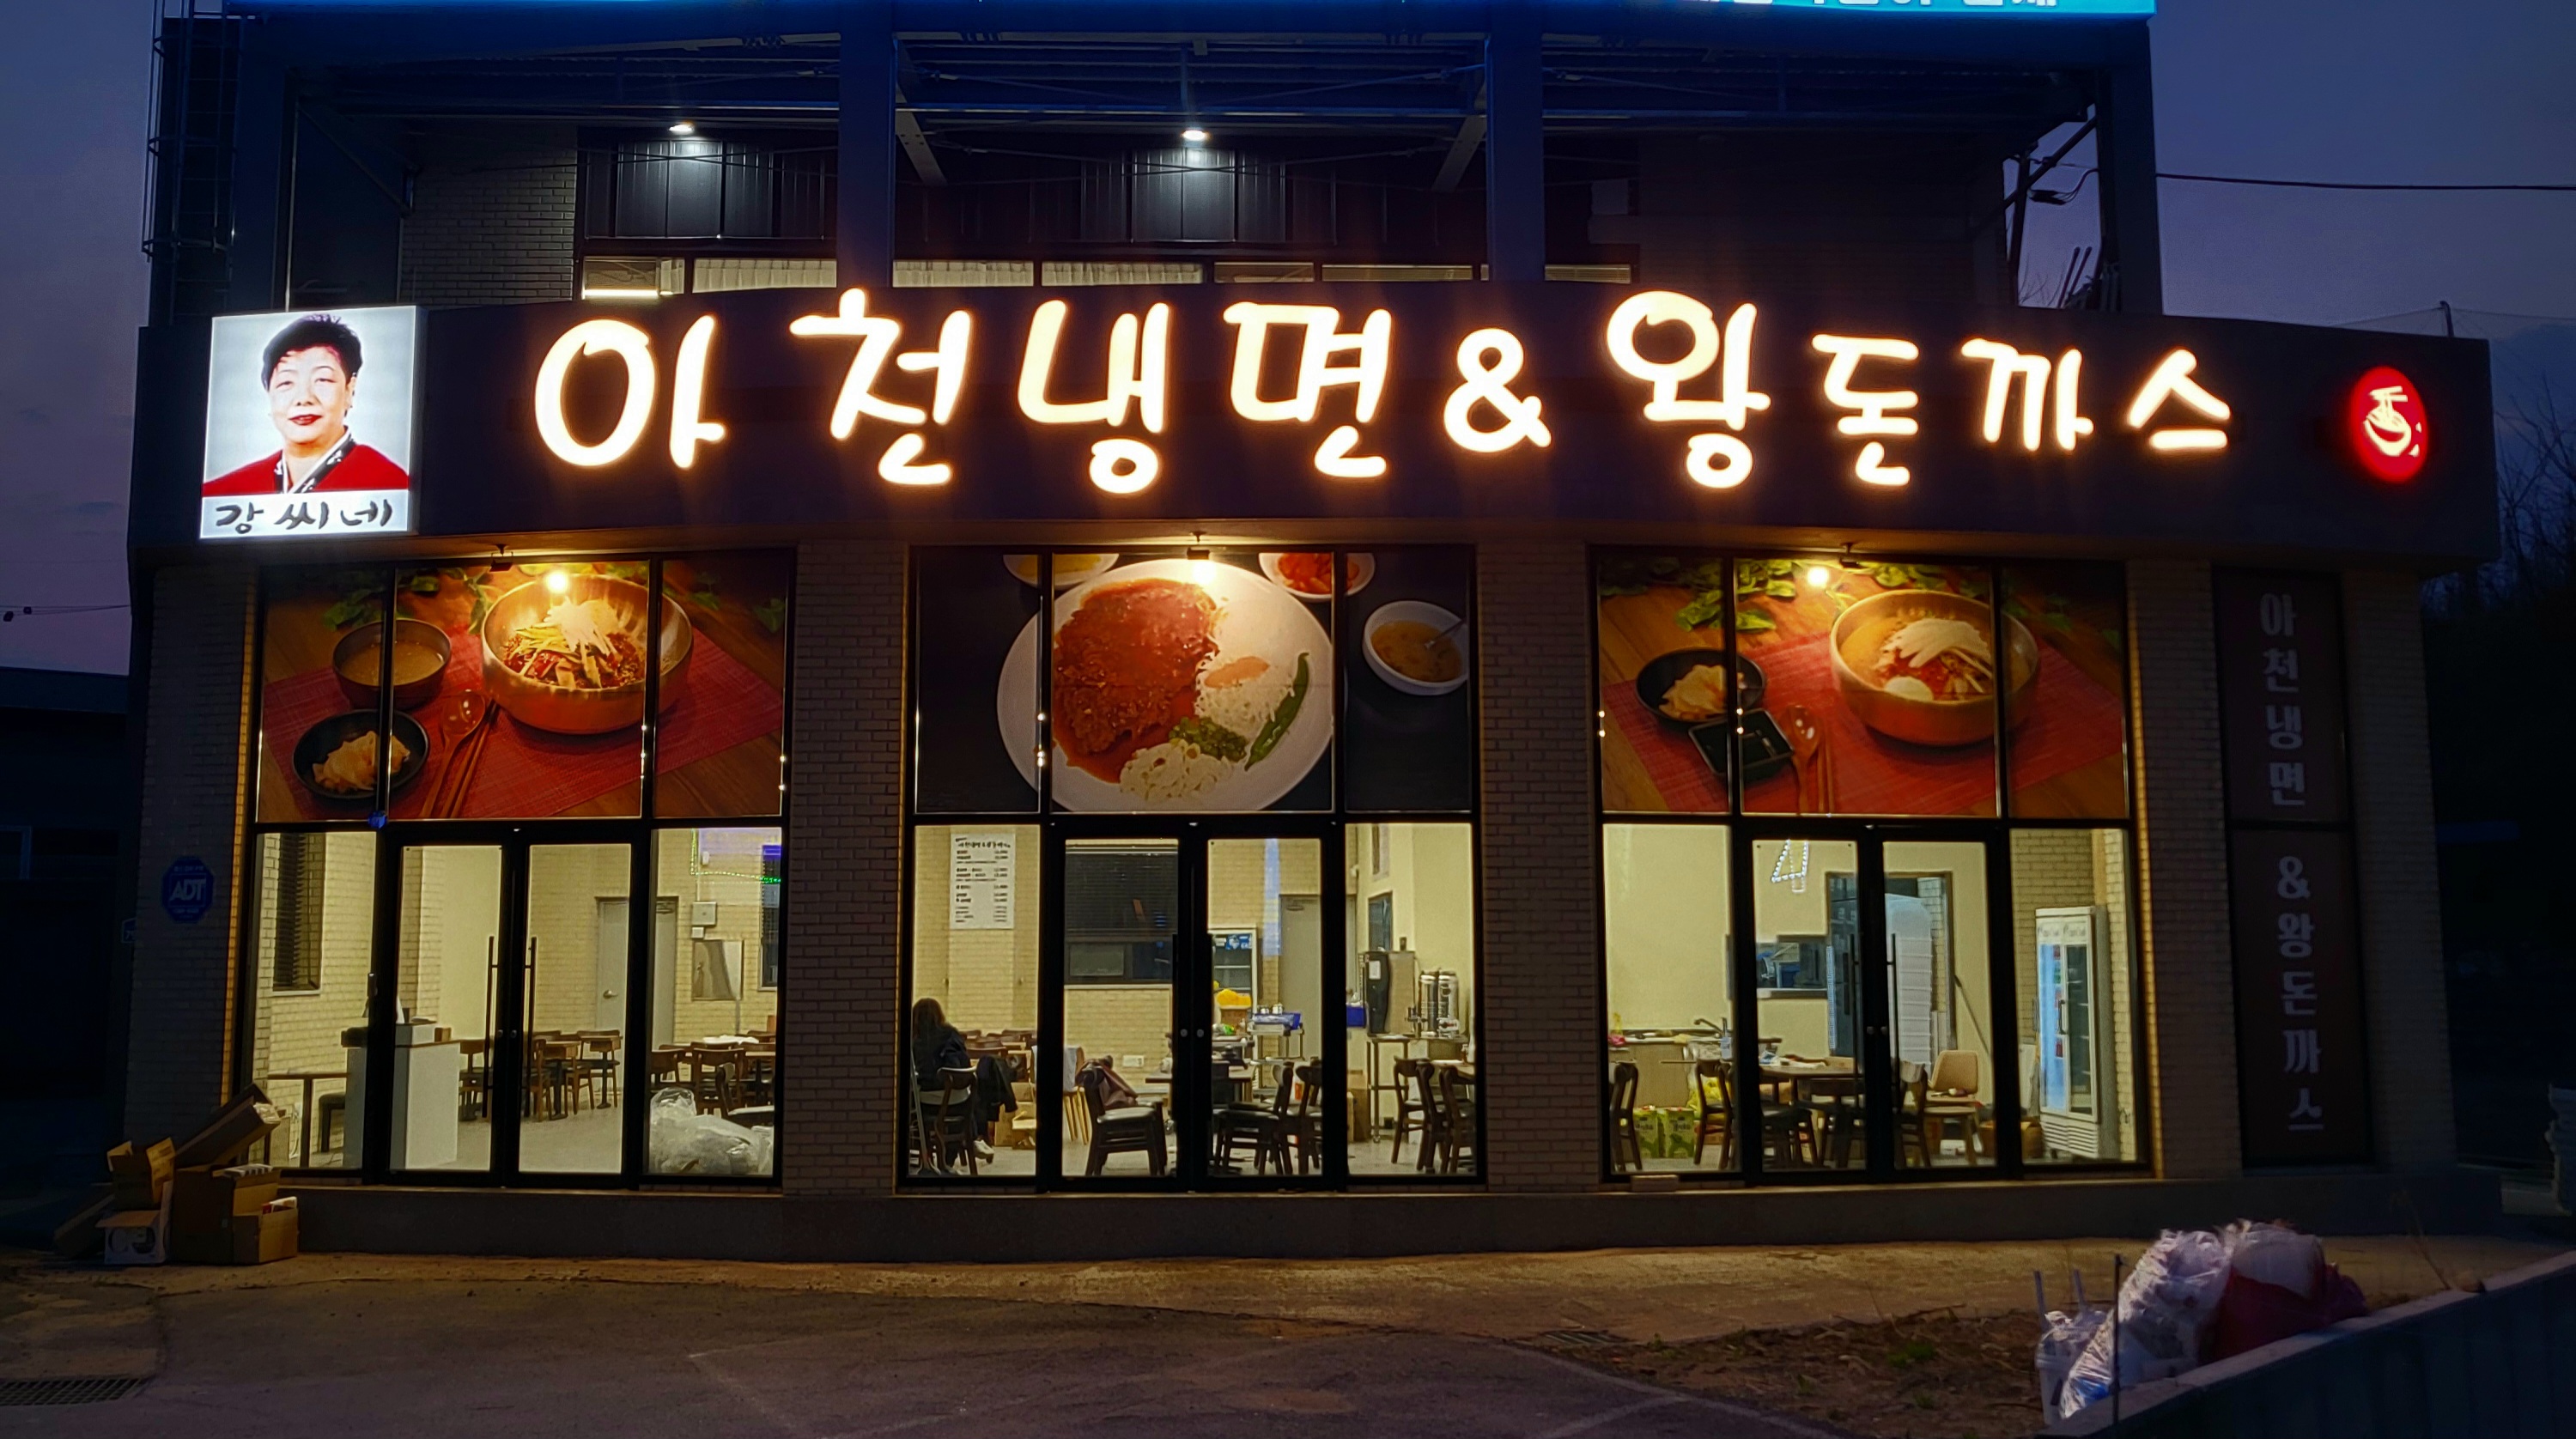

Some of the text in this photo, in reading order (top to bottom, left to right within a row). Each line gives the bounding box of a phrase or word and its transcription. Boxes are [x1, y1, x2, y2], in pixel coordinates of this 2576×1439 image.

[534, 288, 2231, 494] 아천냉면 & 왕돈까스
[216, 498, 393, 534] 강씨네
[169, 878, 207, 901] ADT
